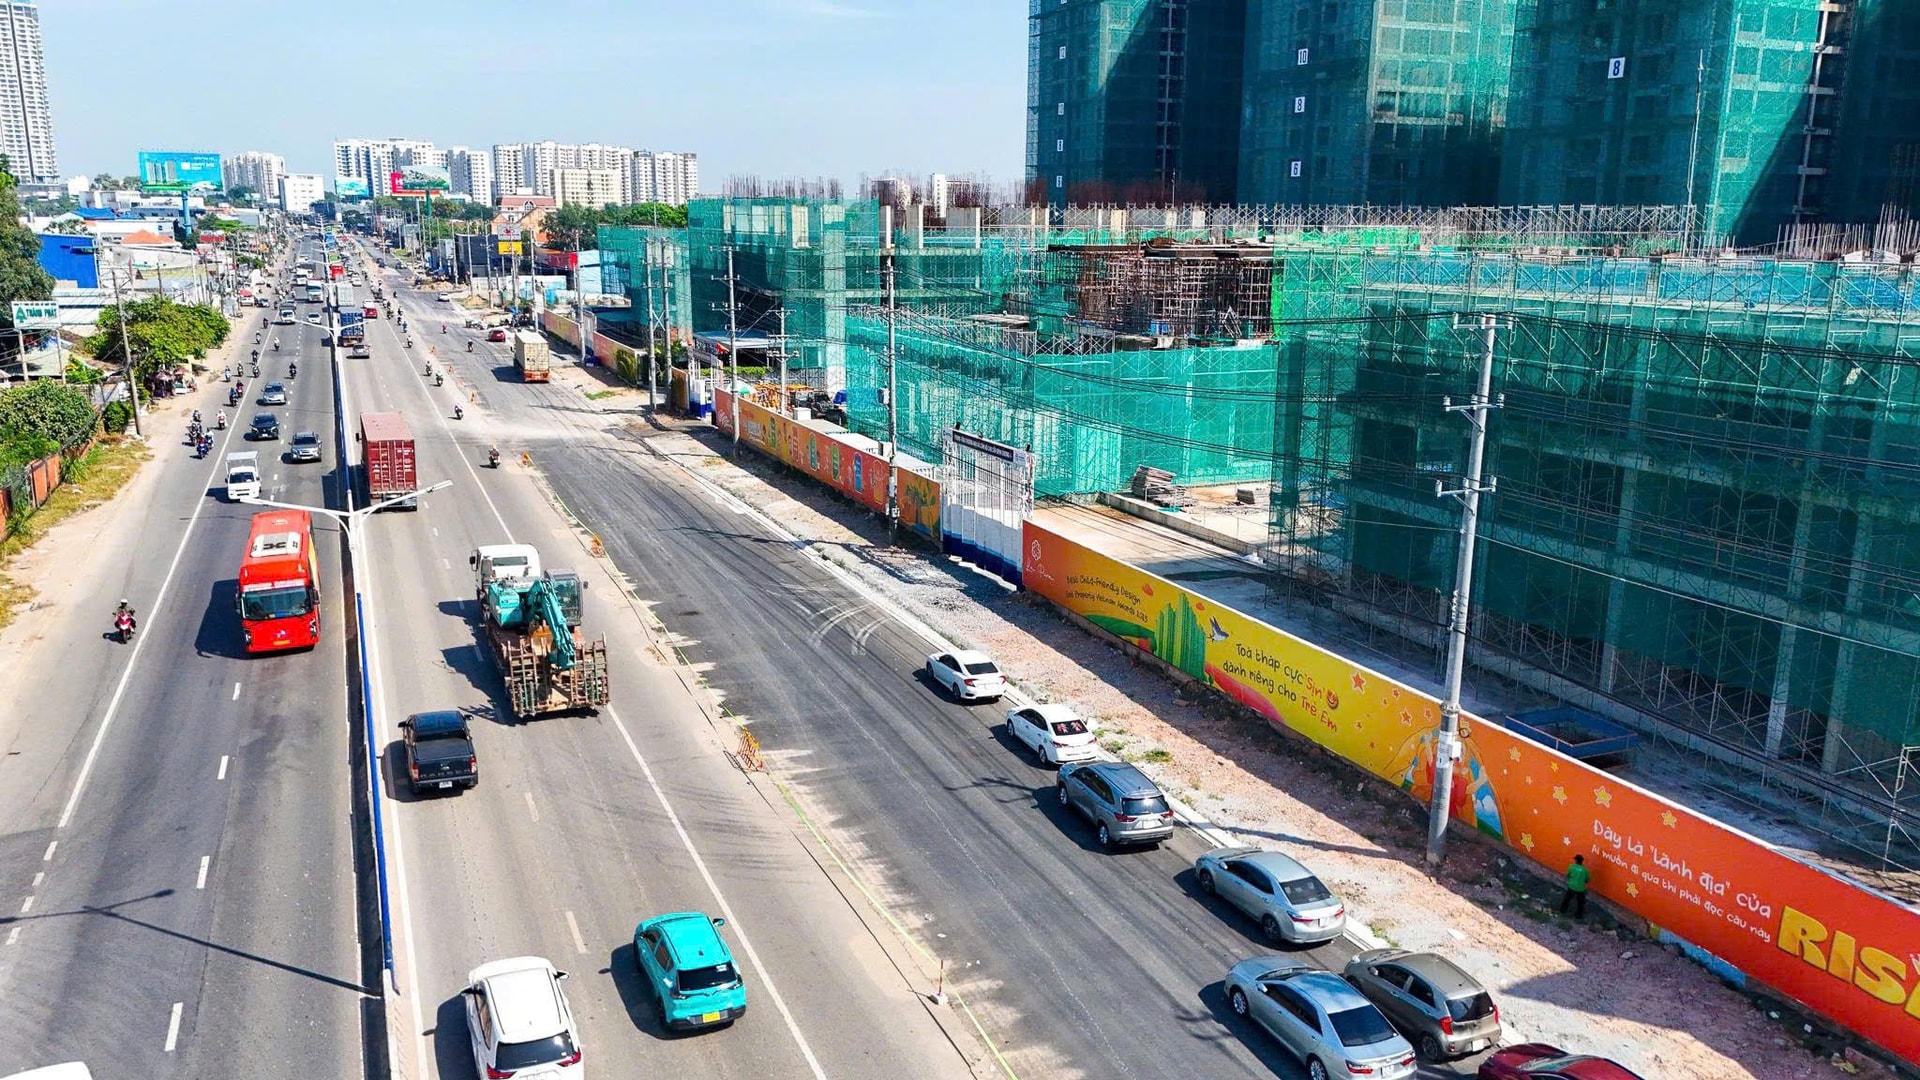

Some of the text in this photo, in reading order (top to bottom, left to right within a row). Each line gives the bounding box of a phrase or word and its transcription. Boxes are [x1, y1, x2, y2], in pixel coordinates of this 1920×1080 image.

[1613, 60, 1621, 76] 8
[1120, 586, 1141, 606] Design
[1255, 648, 1281, 673] tháp
[1284, 665, 1304, 685] cực
[1223, 660, 1338, 733] dành riêng cho Trẻ Em
[1591, 844, 1600, 855] Ai
[1602, 849, 1628, 869] muốn
[1630, 864, 1639, 875] đi
[1641, 870, 1659, 885] qua
[1679, 888, 1701, 906] phải
[1703, 900, 1724, 917] đọc
[1749, 924, 1771, 943] này
[1592, 819, 1622, 849] Đây
[1627, 836, 1644, 857] là
[1736, 892, 1771, 919] của
